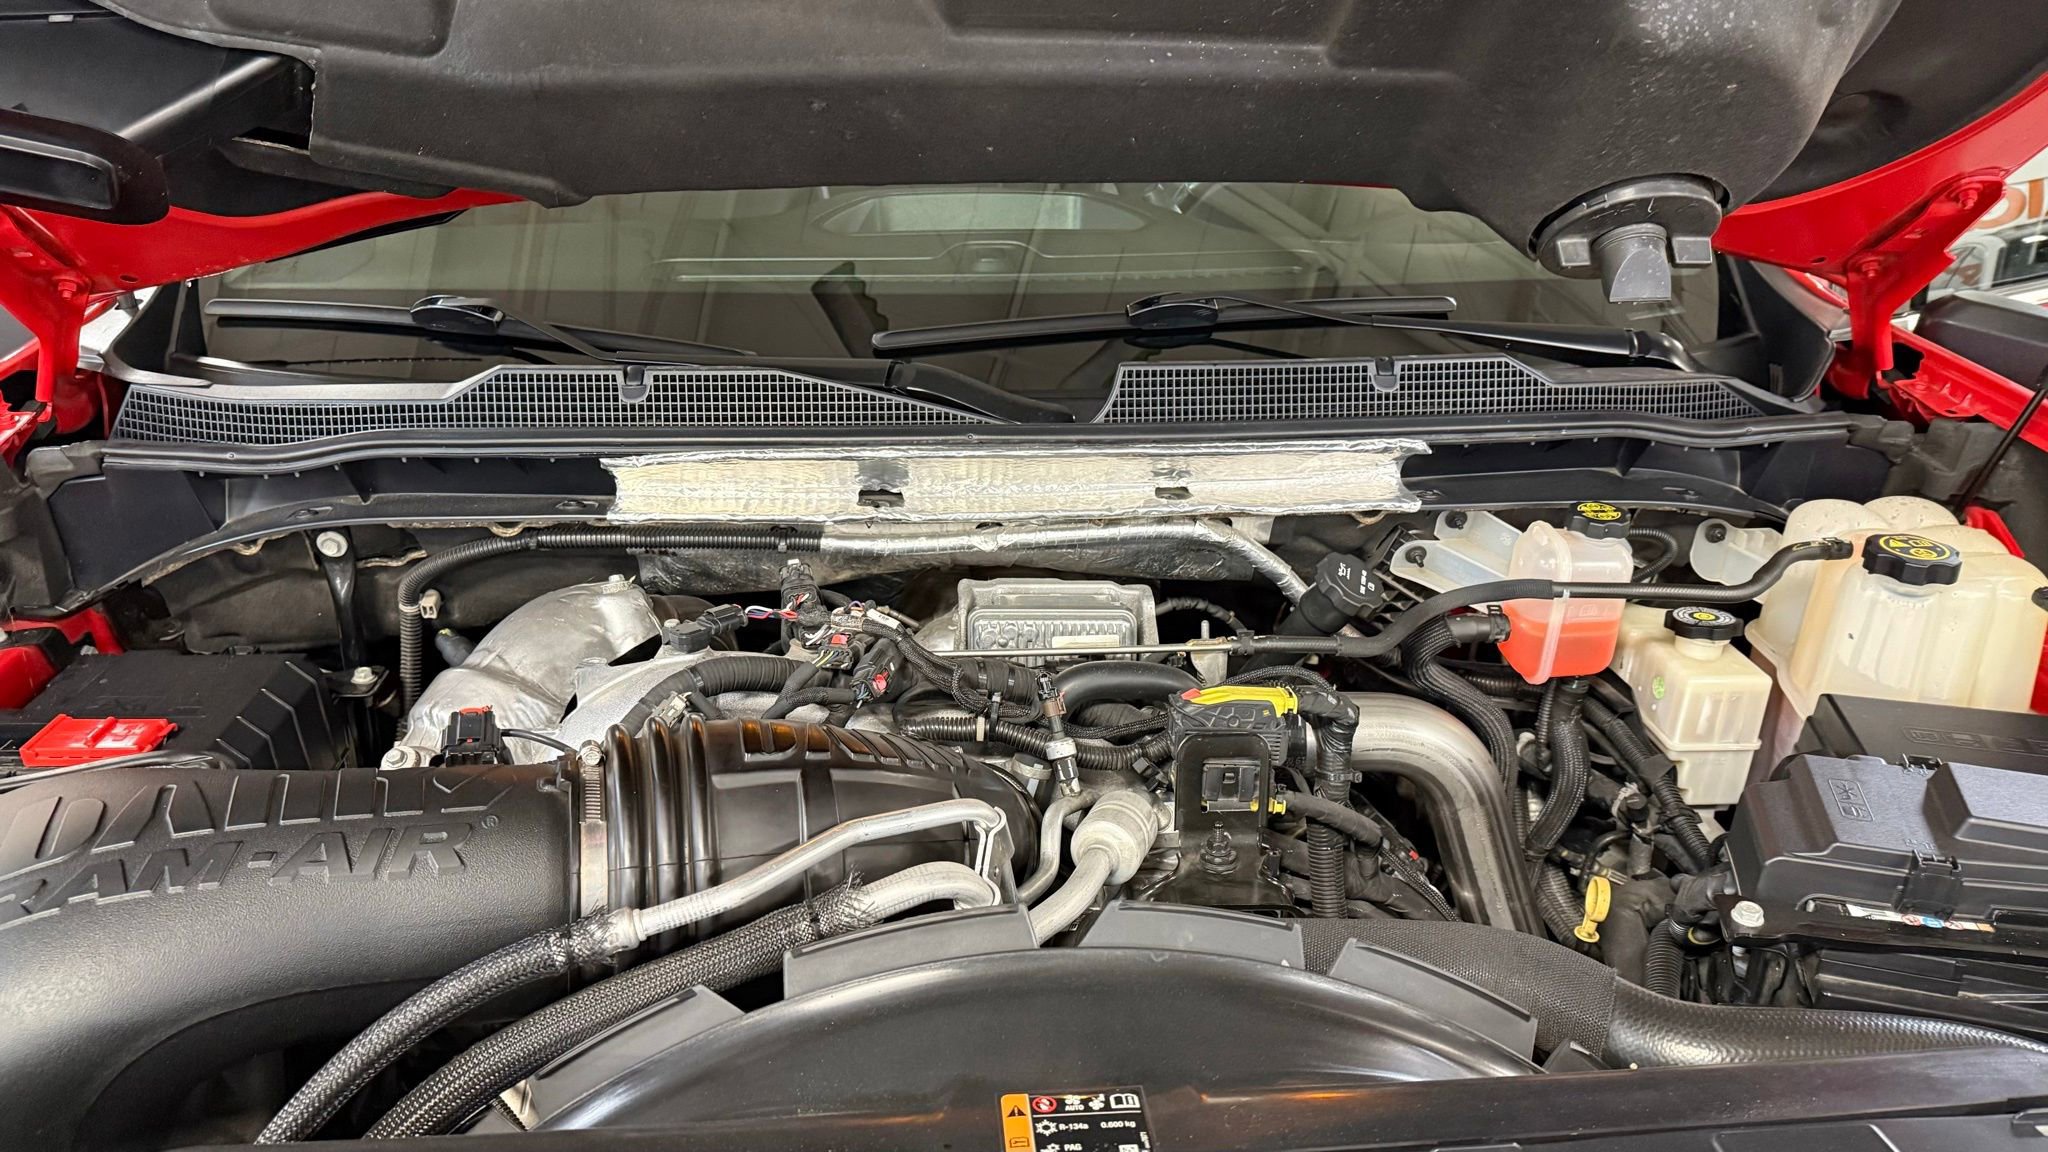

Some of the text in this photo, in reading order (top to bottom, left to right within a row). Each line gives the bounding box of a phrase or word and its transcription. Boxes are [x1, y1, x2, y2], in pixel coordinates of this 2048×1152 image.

[1064, 1103, 1085, 1111] AUTO
[1058, 1122, 1089, 1131] R-134a
[1124, 1120, 1136, 1129] kg
[1063, 1143, 1083, 1152] PAG
